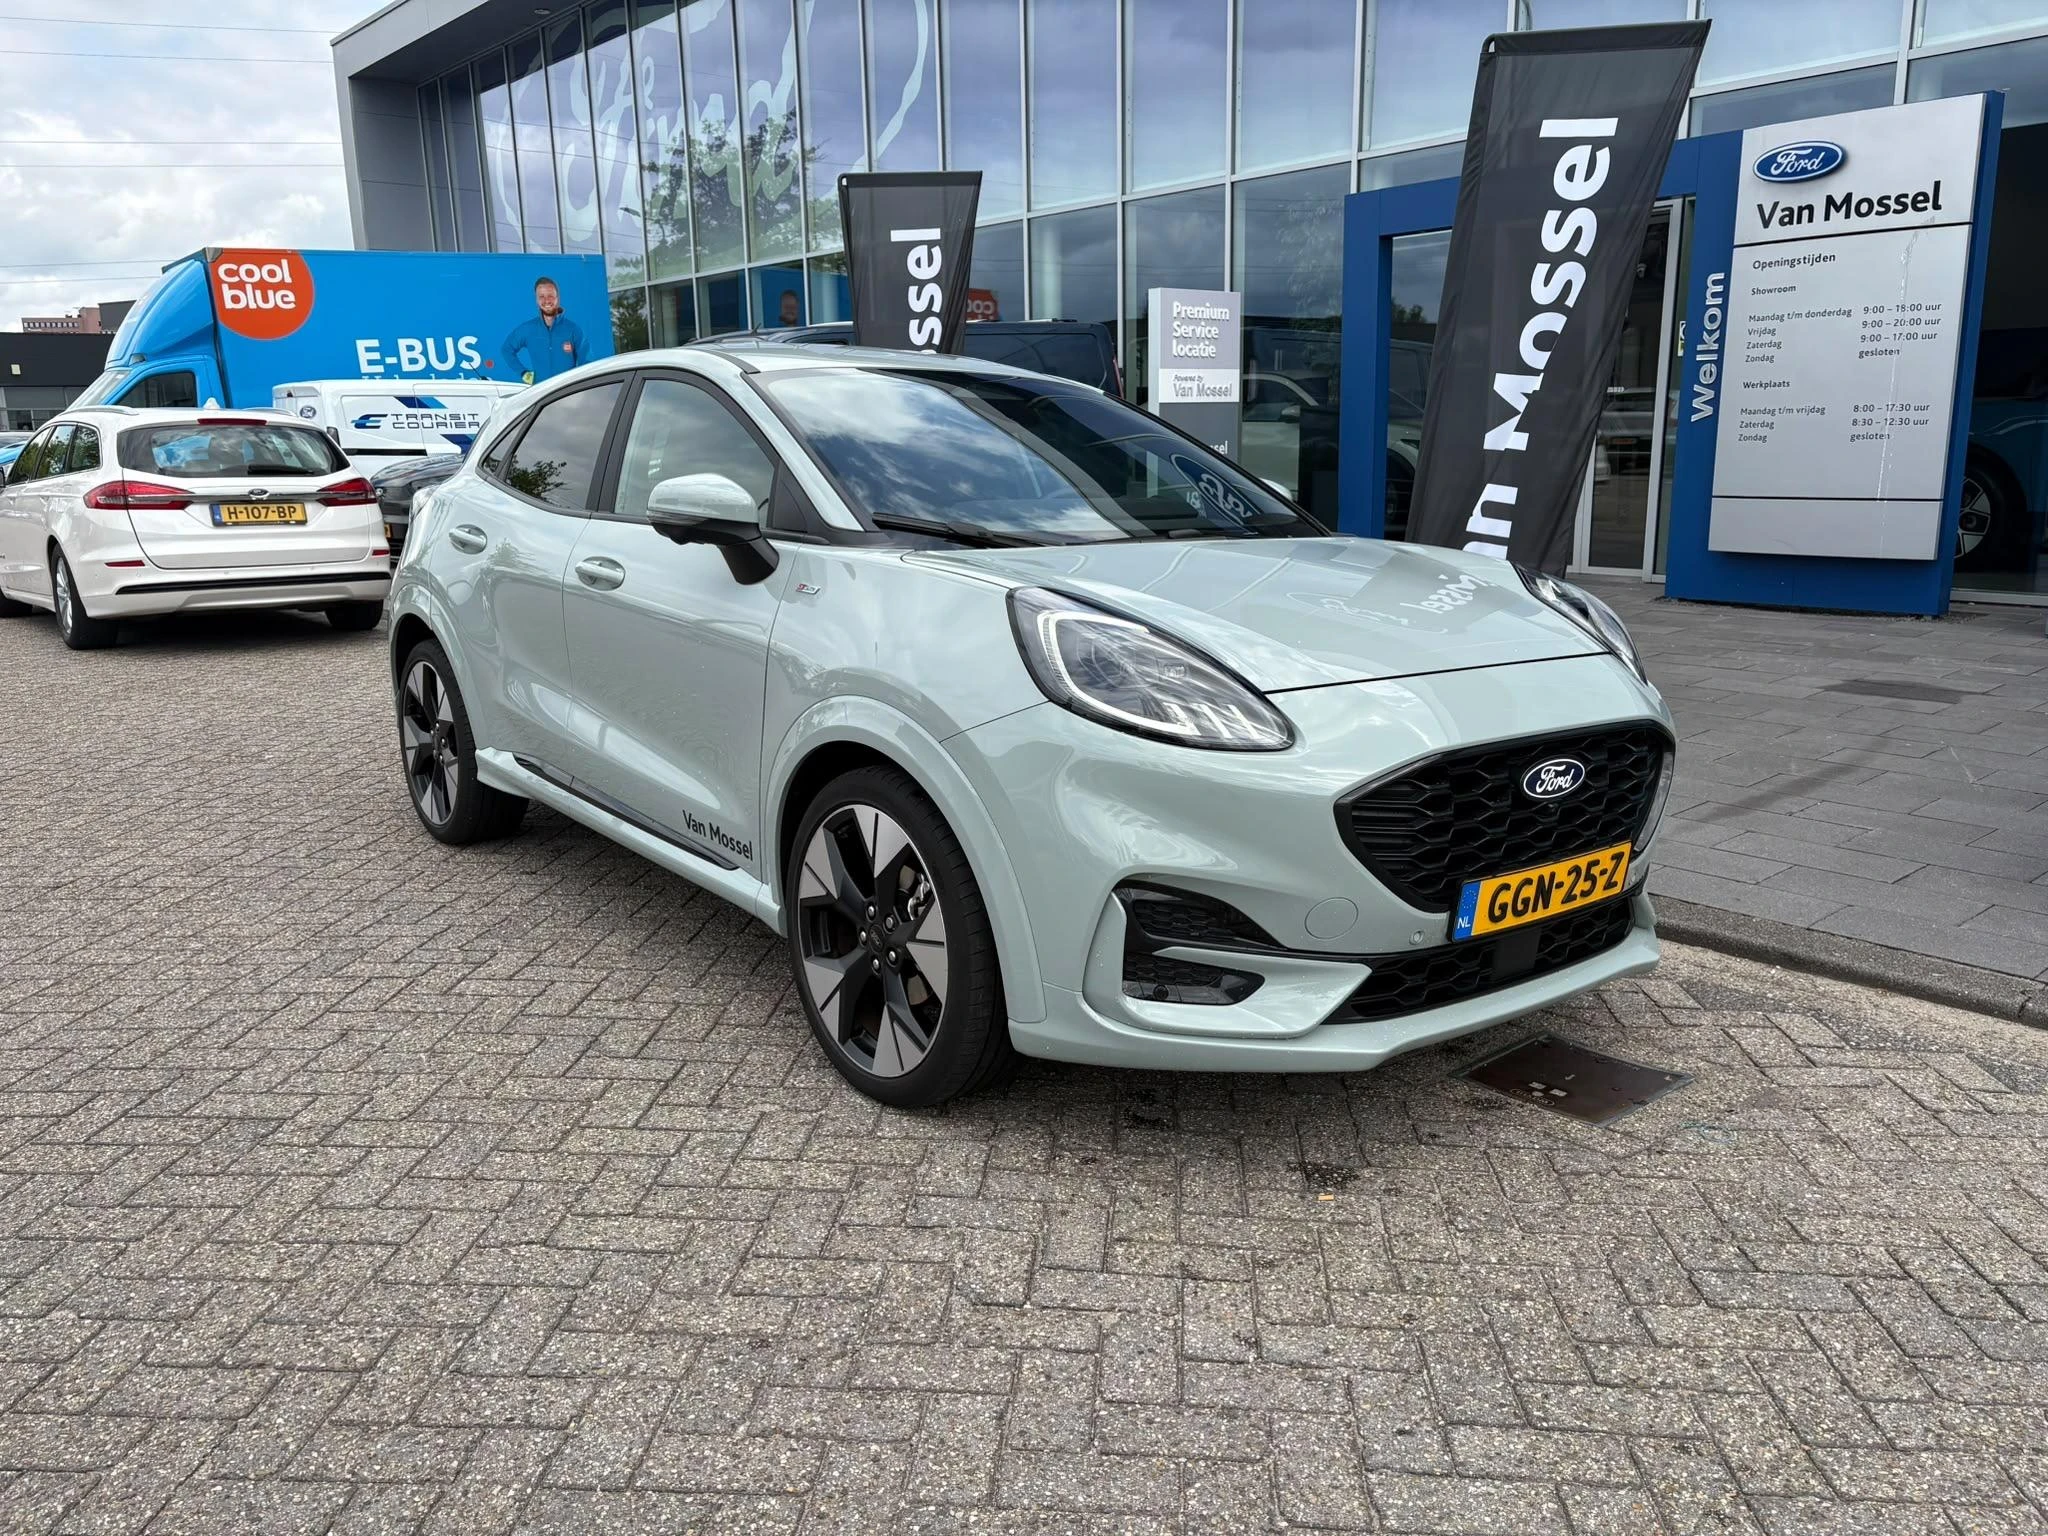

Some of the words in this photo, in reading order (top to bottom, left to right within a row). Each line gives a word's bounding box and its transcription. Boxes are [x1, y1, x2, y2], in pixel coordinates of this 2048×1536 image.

[1756, 201, 1815, 230] Van
[1824, 180, 1942, 222] Mossel
[217, 258, 293, 283] cool
[1752, 253, 1836, 271] Openingstijden
[221, 283, 297, 310] blue
[890, 228, 942, 354] ssel
[1751, 285, 1797, 296] Showroom
[1172, 301, 1230, 320] Premium
[1748, 313, 1785, 323] Maandag
[1786, 310, 1803, 320] t/m
[1804, 307, 1853, 318] donderdag
[1863, 305, 1885, 315] 9:00
[1895, 303, 1922, 313] 18:00
[1925, 303, 1942, 312] uur
[1172, 321, 1219, 340] Service
[1747, 327, 1777, 338] Vrijdag
[1861, 320, 1884, 329] 9:00
[1893, 318, 1922, 327] 20:00
[1924, 317, 1941, 326] uur
[1172, 340, 1216, 358] locatie
[1690, 272, 1725, 422] Welkom
[1746, 340, 1782, 350] Zaterdag
[1860, 334, 1882, 343] 9:00
[1892, 332, 1919, 341] 17:00
[1921, 331, 1938, 340] uur
[1745, 354, 1775, 364] Zondag
[1858, 348, 1900, 359] gesloten
[1173, 383, 1193, 397] Van
[1196, 383, 1232, 398] Mossel
[1743, 380, 1791, 391] Werkplaats
[391, 413, 479, 421] TRANSIT
[1740, 407, 1777, 417] Maandag
[1778, 406, 1794, 415] t/m
[1795, 405, 1826, 416] vrijdag
[1853, 404, 1875, 413] 8:00
[1885, 403, 1911, 412] 17:30
[1913, 404, 1930, 412] uur
[392, 421, 480, 430] COURIER
[1739, 420, 1775, 430] Zaterdag
[1851, 418, 1873, 427] 8:30
[1884, 417, 1910, 426] 12:30
[1912, 417, 1929, 426] uur
[1738, 433, 1768, 443] Zondag
[1849, 432, 1890, 443] gesloten
[227, 505, 297, 521] H-107-BP
[682, 809, 707, 838] Van
[709, 822, 753, 862] Mossel
[1487, 851, 1625, 924] GGN-25-Z
[1457, 916, 1471, 929] NL
